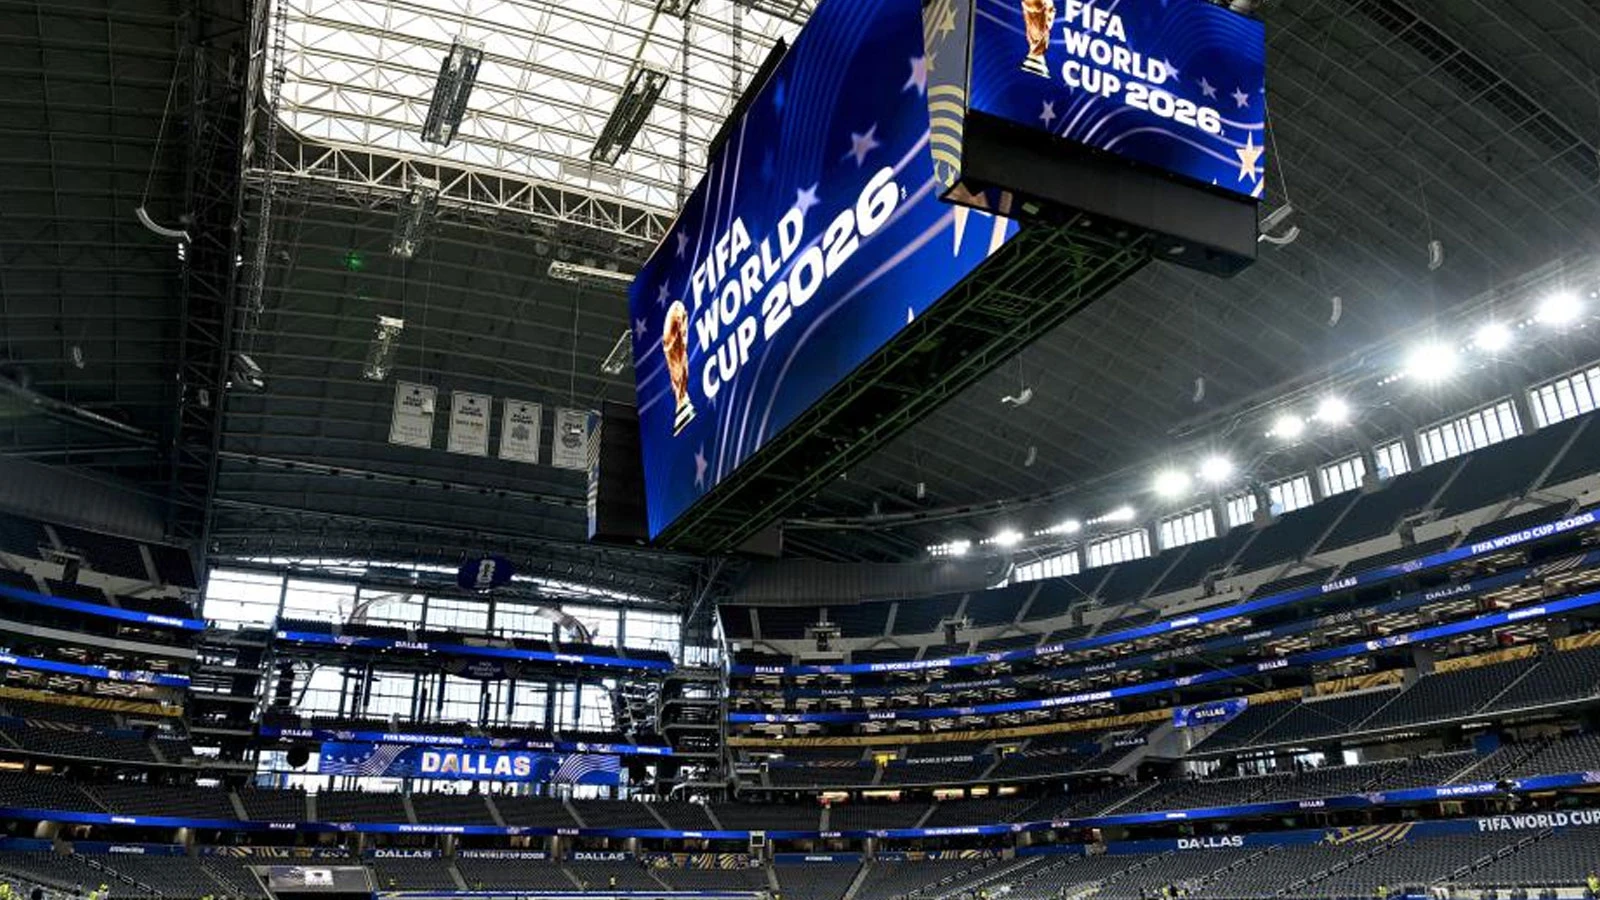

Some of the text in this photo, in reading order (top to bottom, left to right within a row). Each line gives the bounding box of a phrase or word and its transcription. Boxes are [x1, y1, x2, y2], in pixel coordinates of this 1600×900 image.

[1066, 0, 1127, 43] FIFA
[1063, 27, 1168, 85] WORLD
[1062, 61, 1222, 135] CUP 2026
[692, 216, 751, 309] FIFA
[696, 207, 804, 352] WORLD
[703, 166, 899, 399] CUP 2026
[1471, 542, 1494, 555] FIFA
[1494, 530, 1532, 548] WORLD
[1532, 524, 1554, 538] CUP
[1321, 576, 1358, 594] DALLAS
[1425, 583, 1471, 601] DALLAS
[421, 752, 531, 776] DALLAS
[1478, 810, 1600, 832] FIFA WORLD CUP
[374, 850, 432, 859] DALLAS
[1177, 834, 1244, 850] DALLAS
[574, 852, 625, 861] DALLAS
